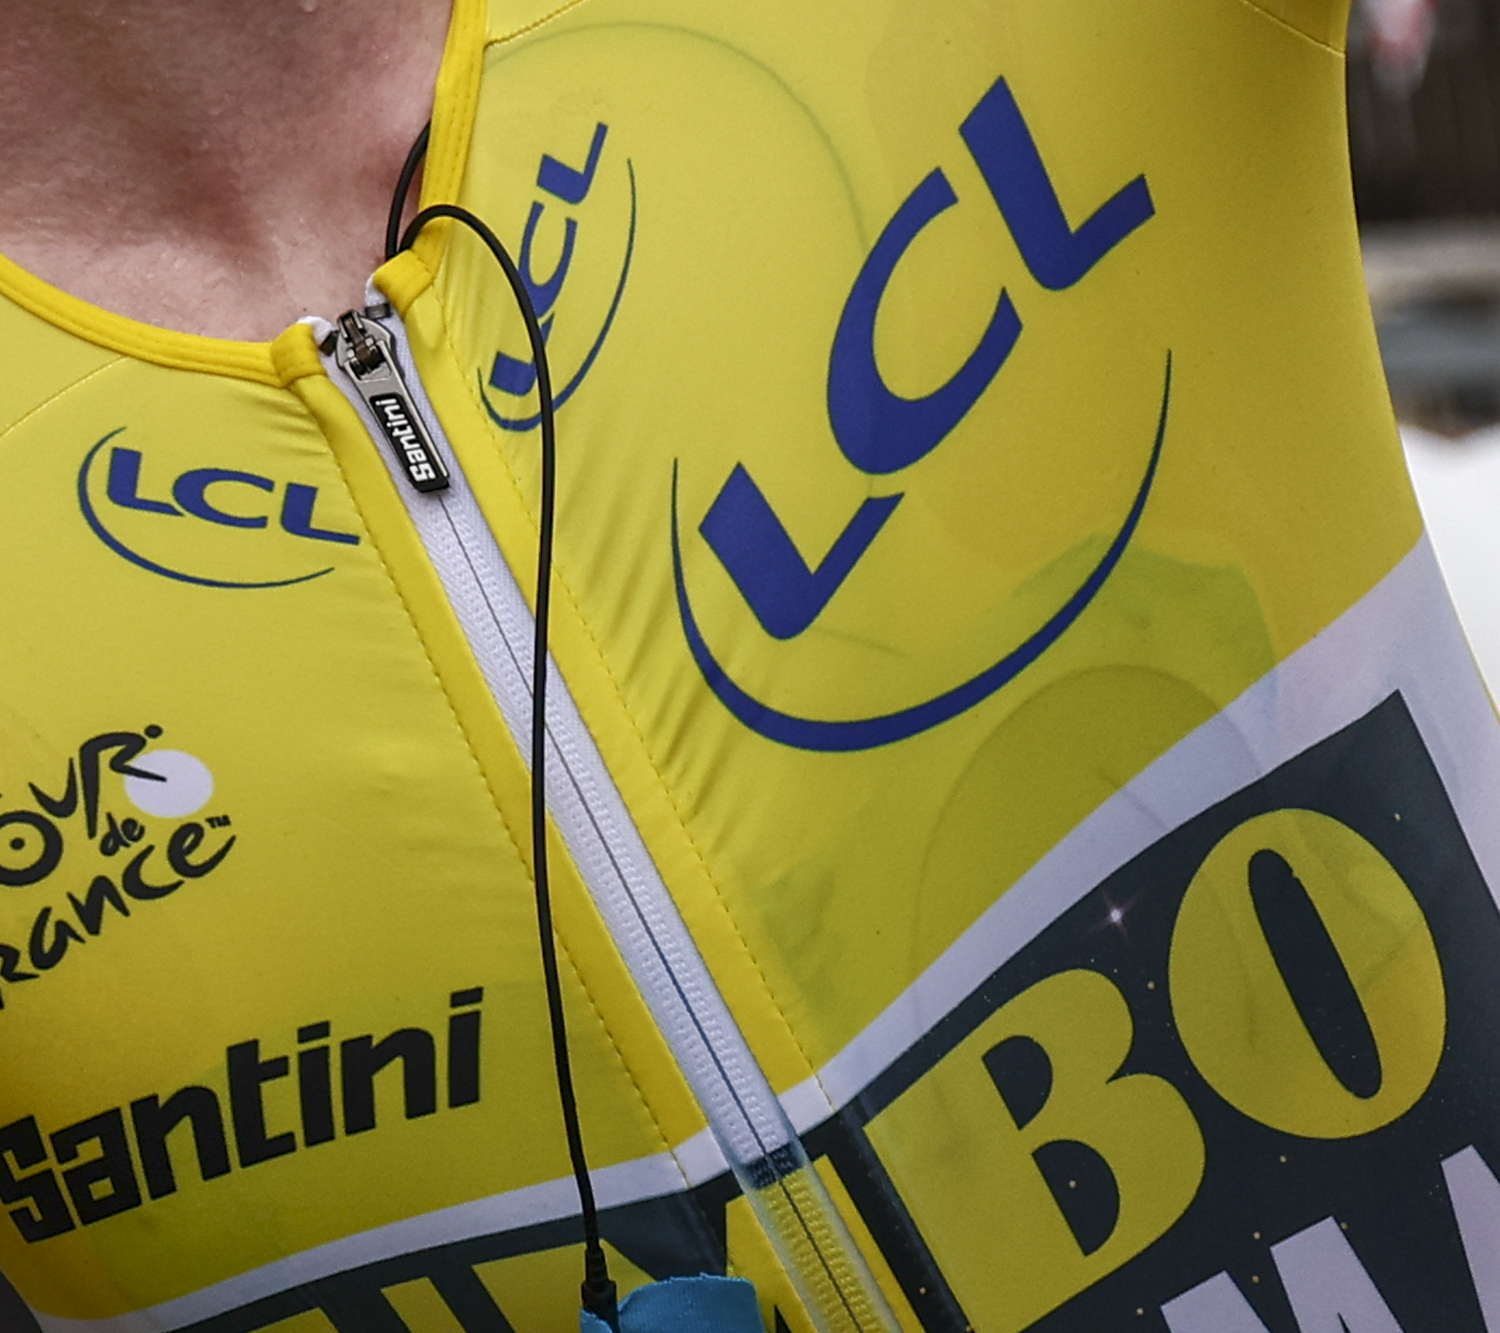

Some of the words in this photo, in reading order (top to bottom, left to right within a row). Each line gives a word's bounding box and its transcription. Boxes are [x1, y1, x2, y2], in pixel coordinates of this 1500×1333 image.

[488, 121, 609, 396] LCL
[375, 397, 436, 482] Santini
[697, 74, 1156, 640] LCL
[107, 447, 360, 546] LCL
[99, 813, 145, 857] de
[727, 805, 1447, 1333] BO
